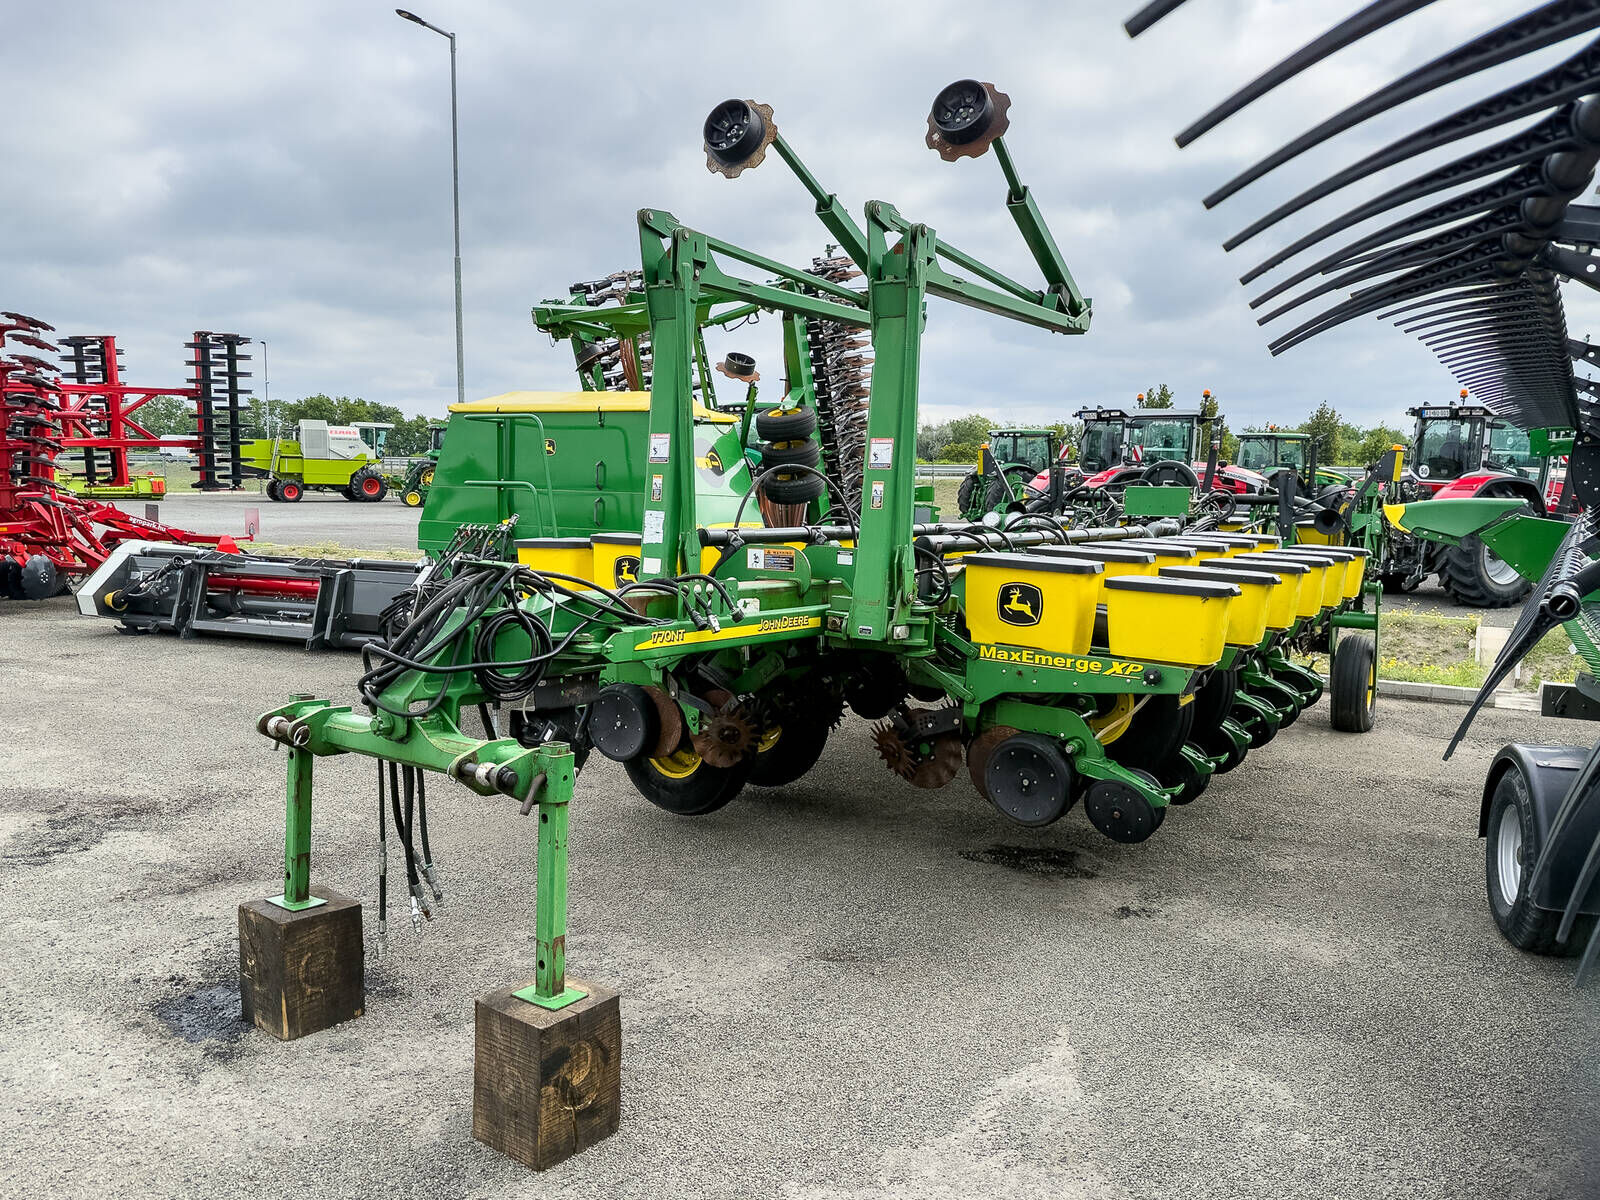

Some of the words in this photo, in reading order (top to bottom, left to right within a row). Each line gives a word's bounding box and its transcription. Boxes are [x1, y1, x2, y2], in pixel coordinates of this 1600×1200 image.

[128, 516, 167, 532] agropark.hu
[758, 618, 782, 632] JOHN
[782, 615, 809, 628] DEERE
[979, 645, 1102, 673] MaxEmerge
[1102, 661, 1144, 676] XP
